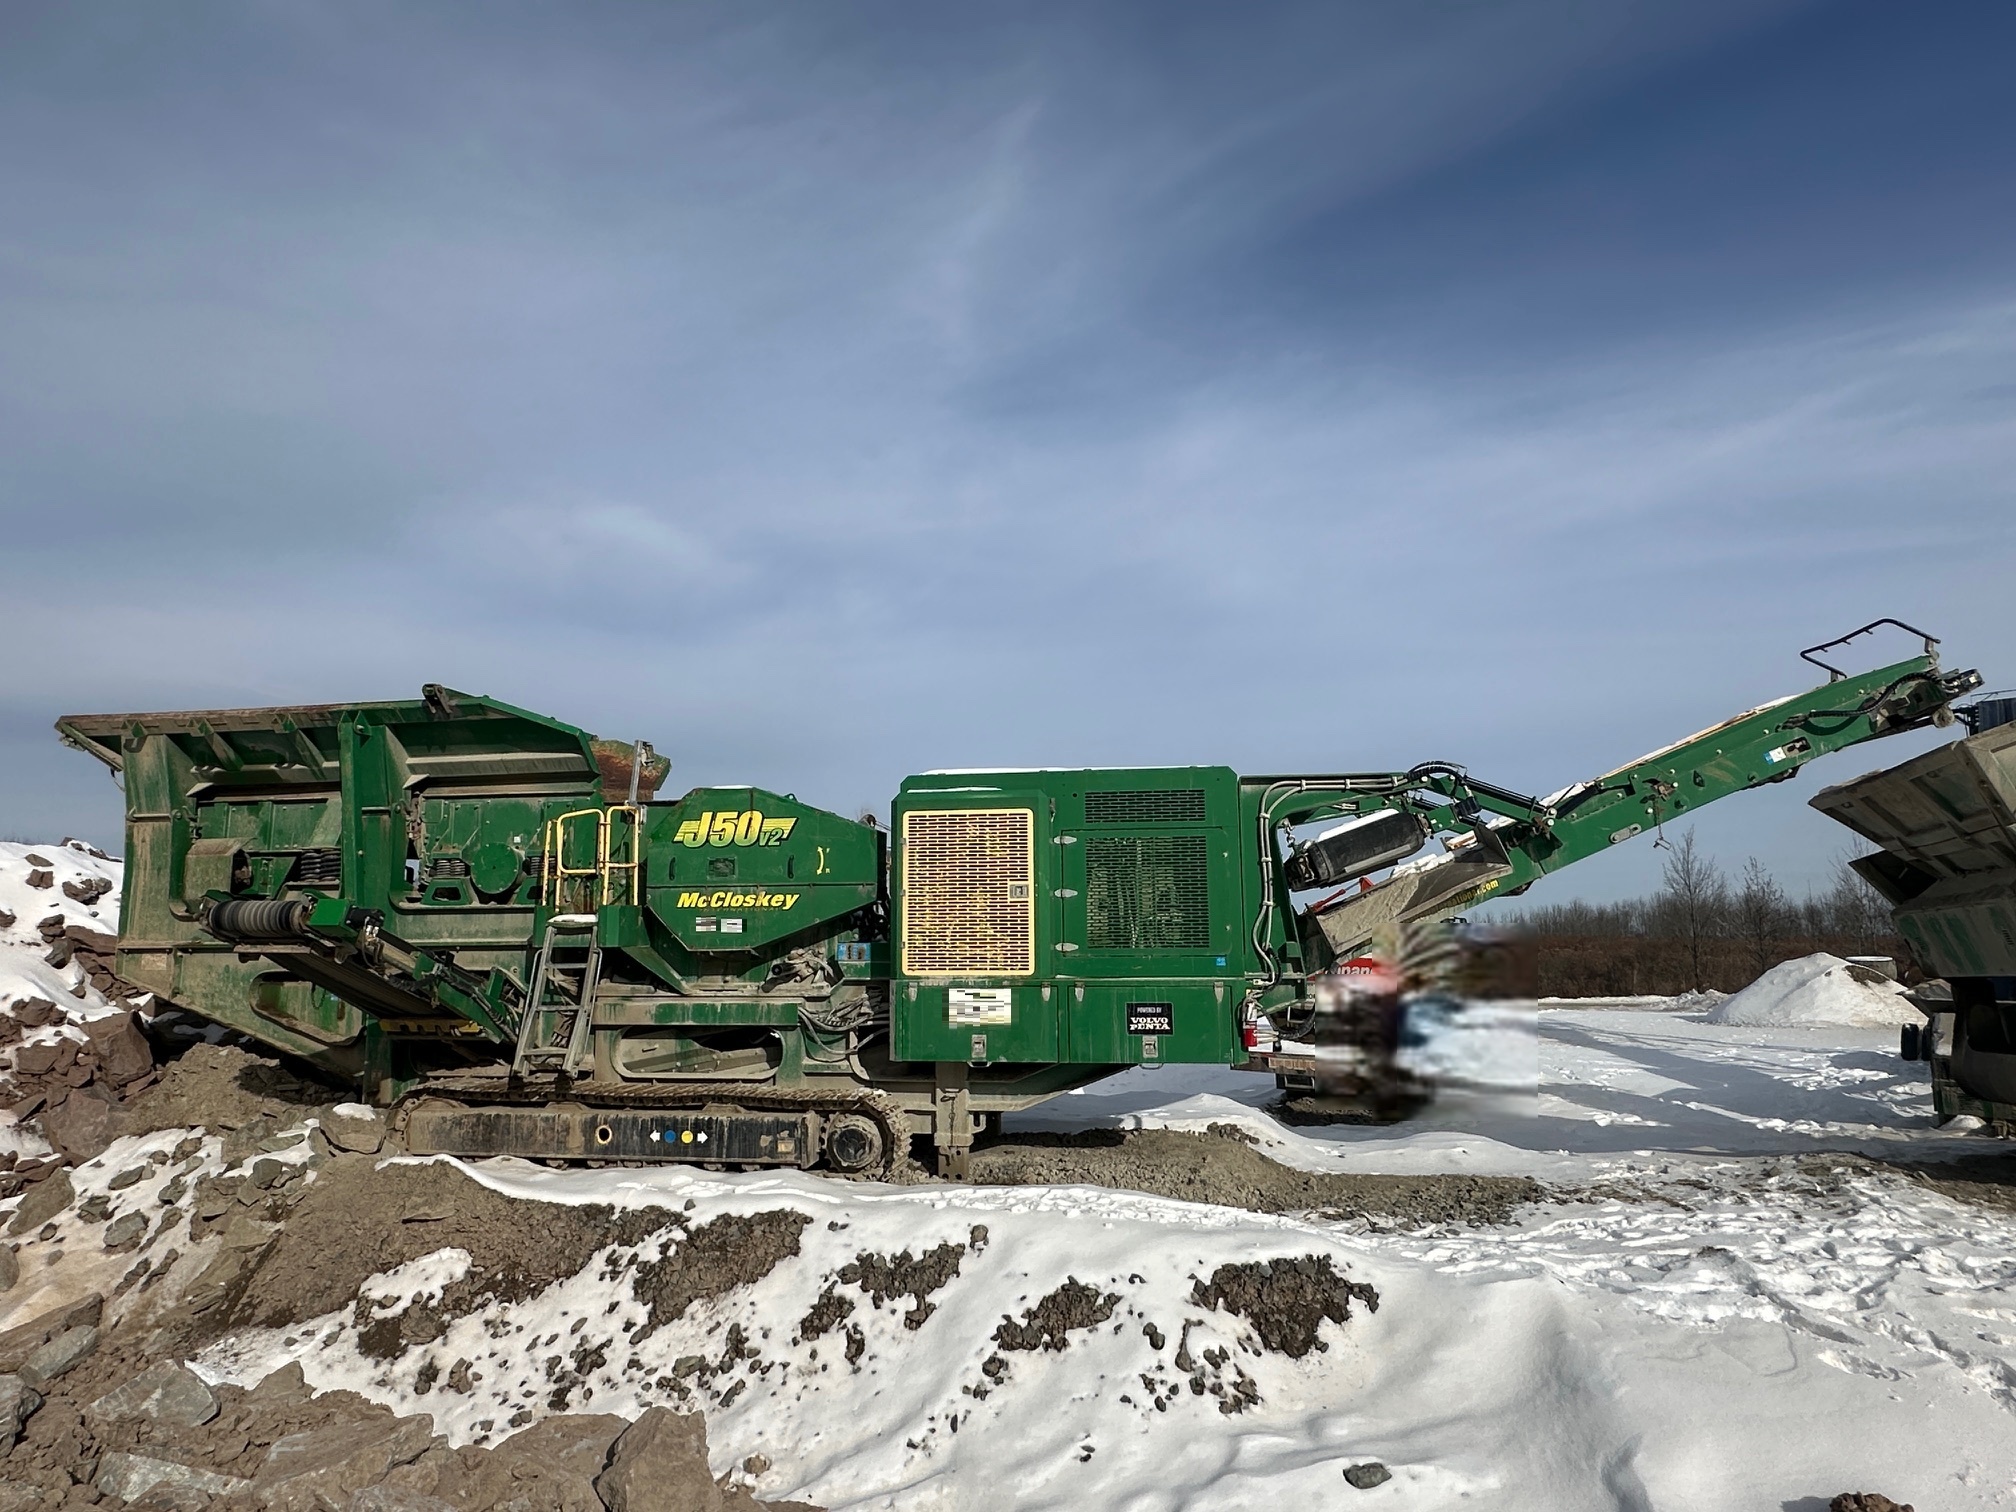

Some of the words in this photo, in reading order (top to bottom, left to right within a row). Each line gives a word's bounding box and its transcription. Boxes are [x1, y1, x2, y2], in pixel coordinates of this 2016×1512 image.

[683, 810, 763, 848] J50
[677, 891, 799, 910] McCloskey
[1130, 1016, 1169, 1024] VOLVO
